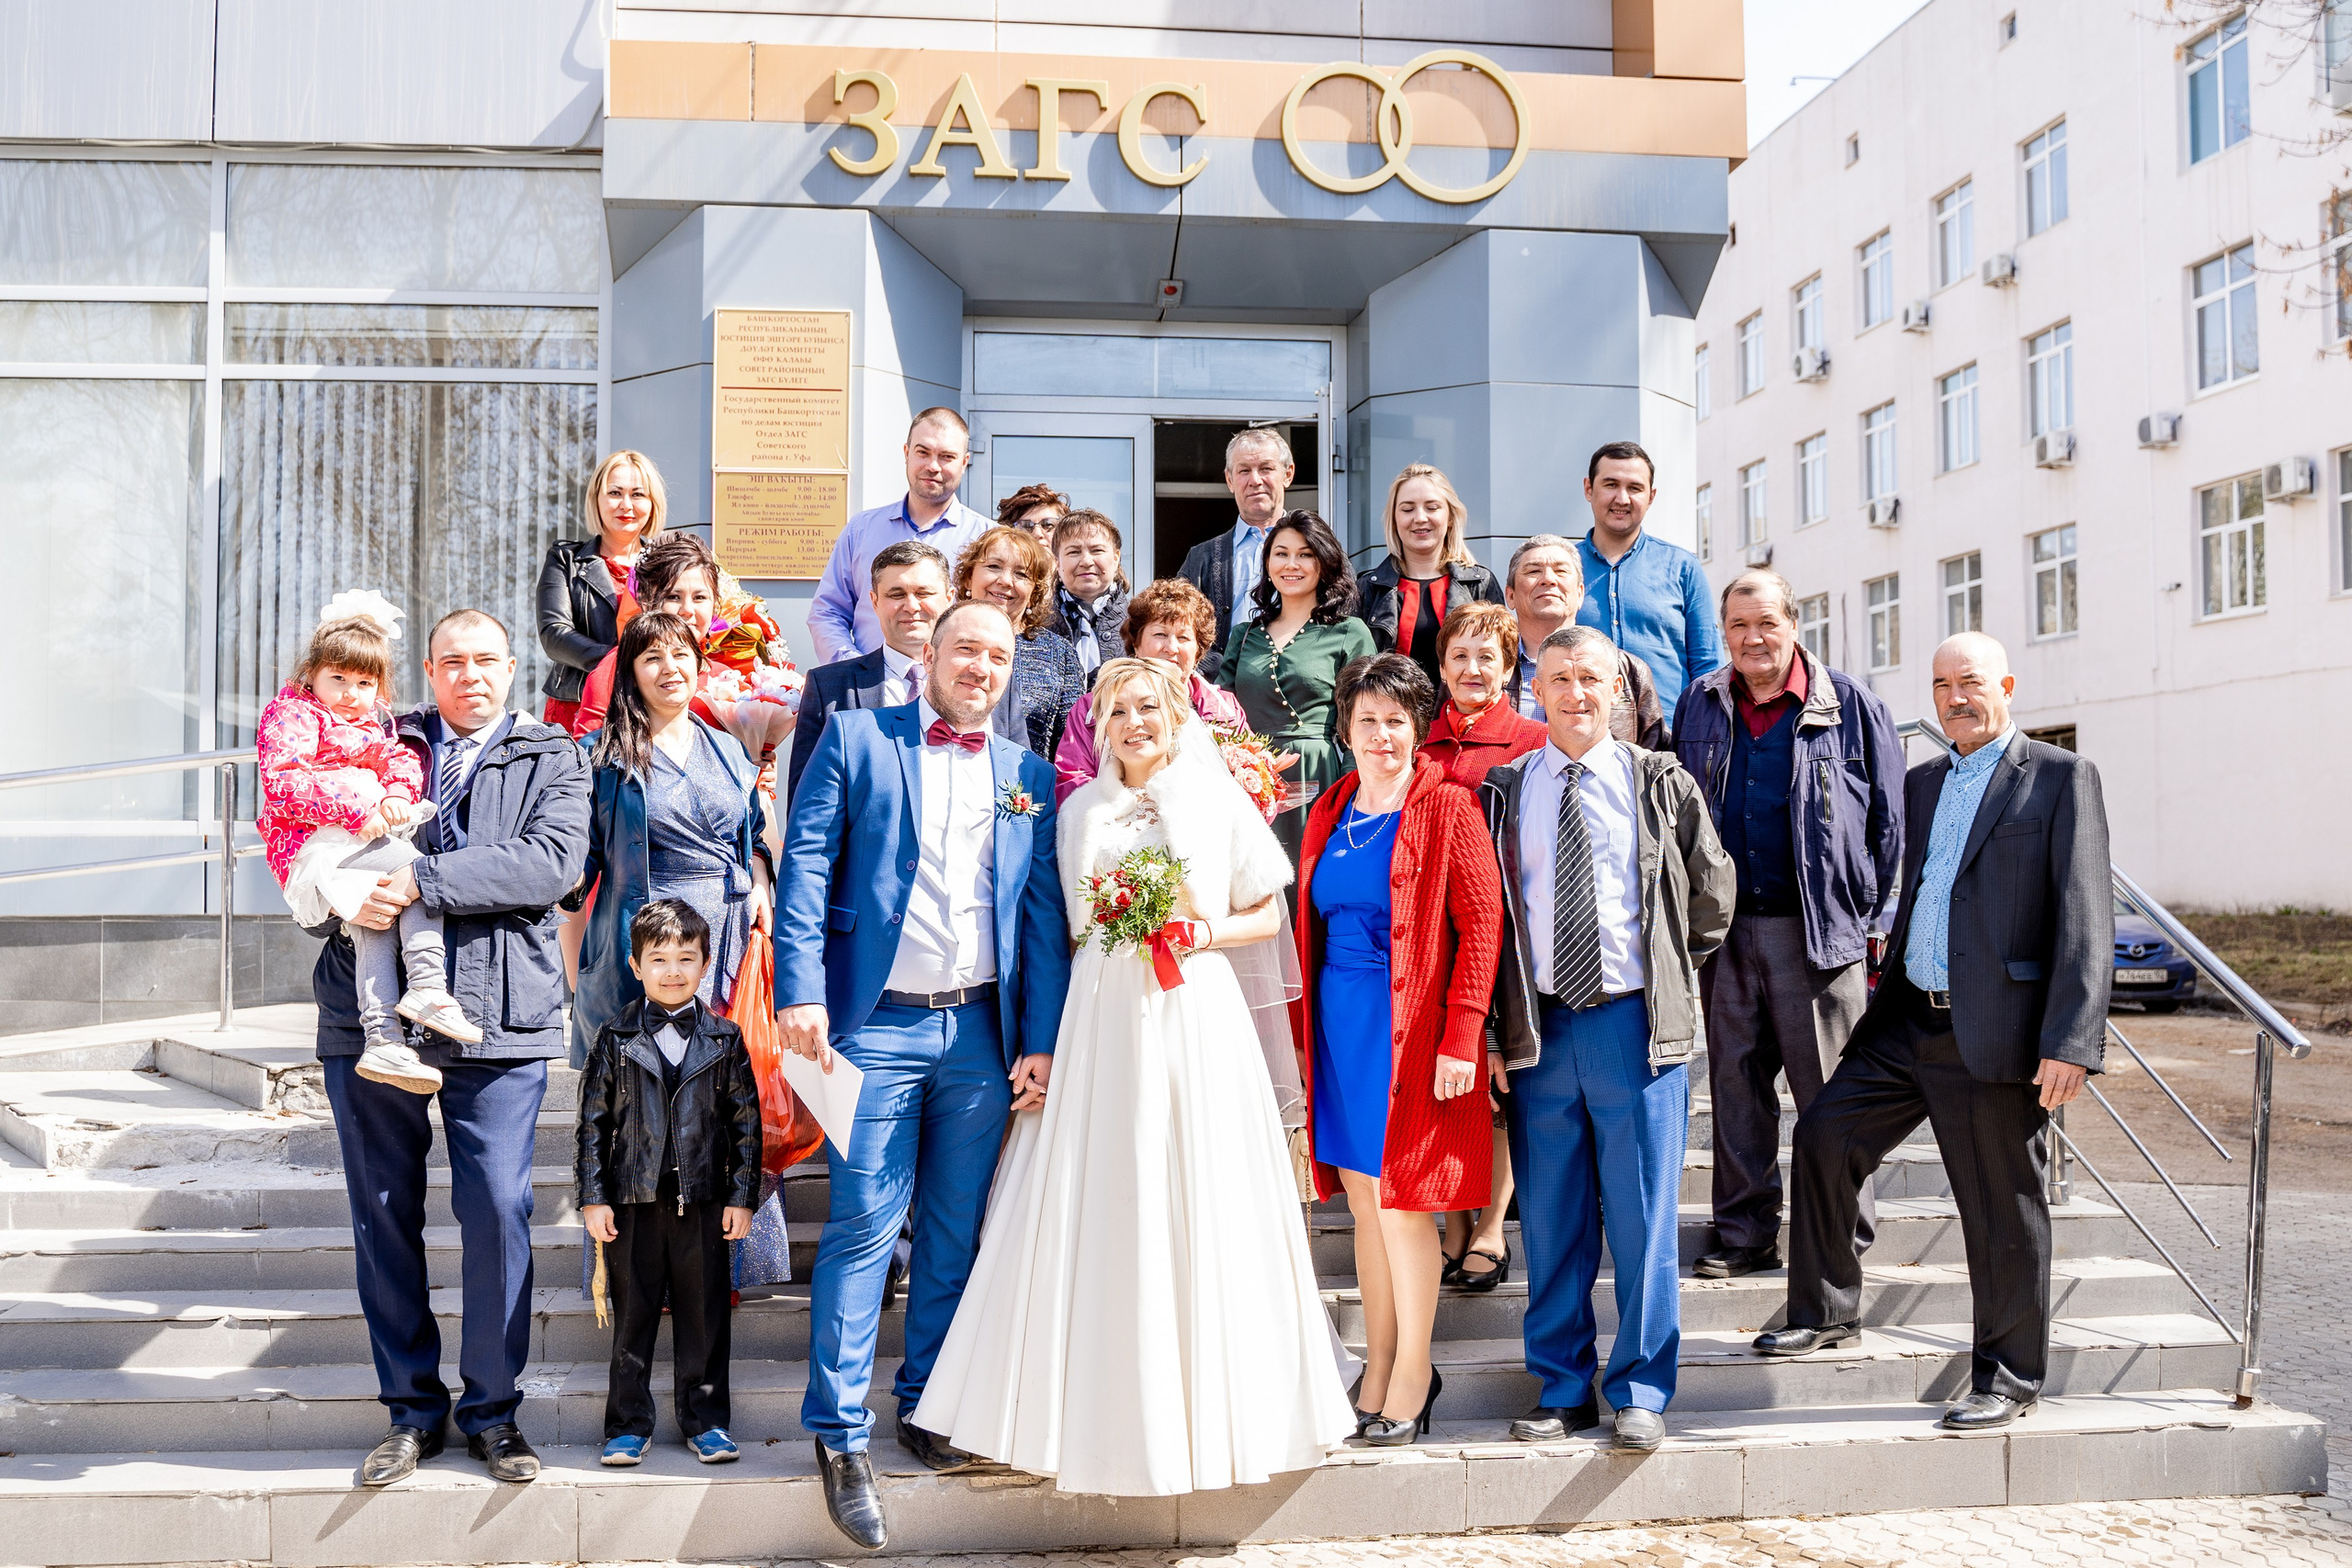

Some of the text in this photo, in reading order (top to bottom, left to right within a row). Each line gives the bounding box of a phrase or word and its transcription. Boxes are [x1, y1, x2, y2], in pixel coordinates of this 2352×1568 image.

[828, 68, 1209, 187] ЗАГС
[804, 336, 845, 344] БУЙЫНСА
[724, 395, 801, 404] Государственный
[723, 407, 841, 417] Республики Башкортостан
[794, 454, 811, 463] Уфа
